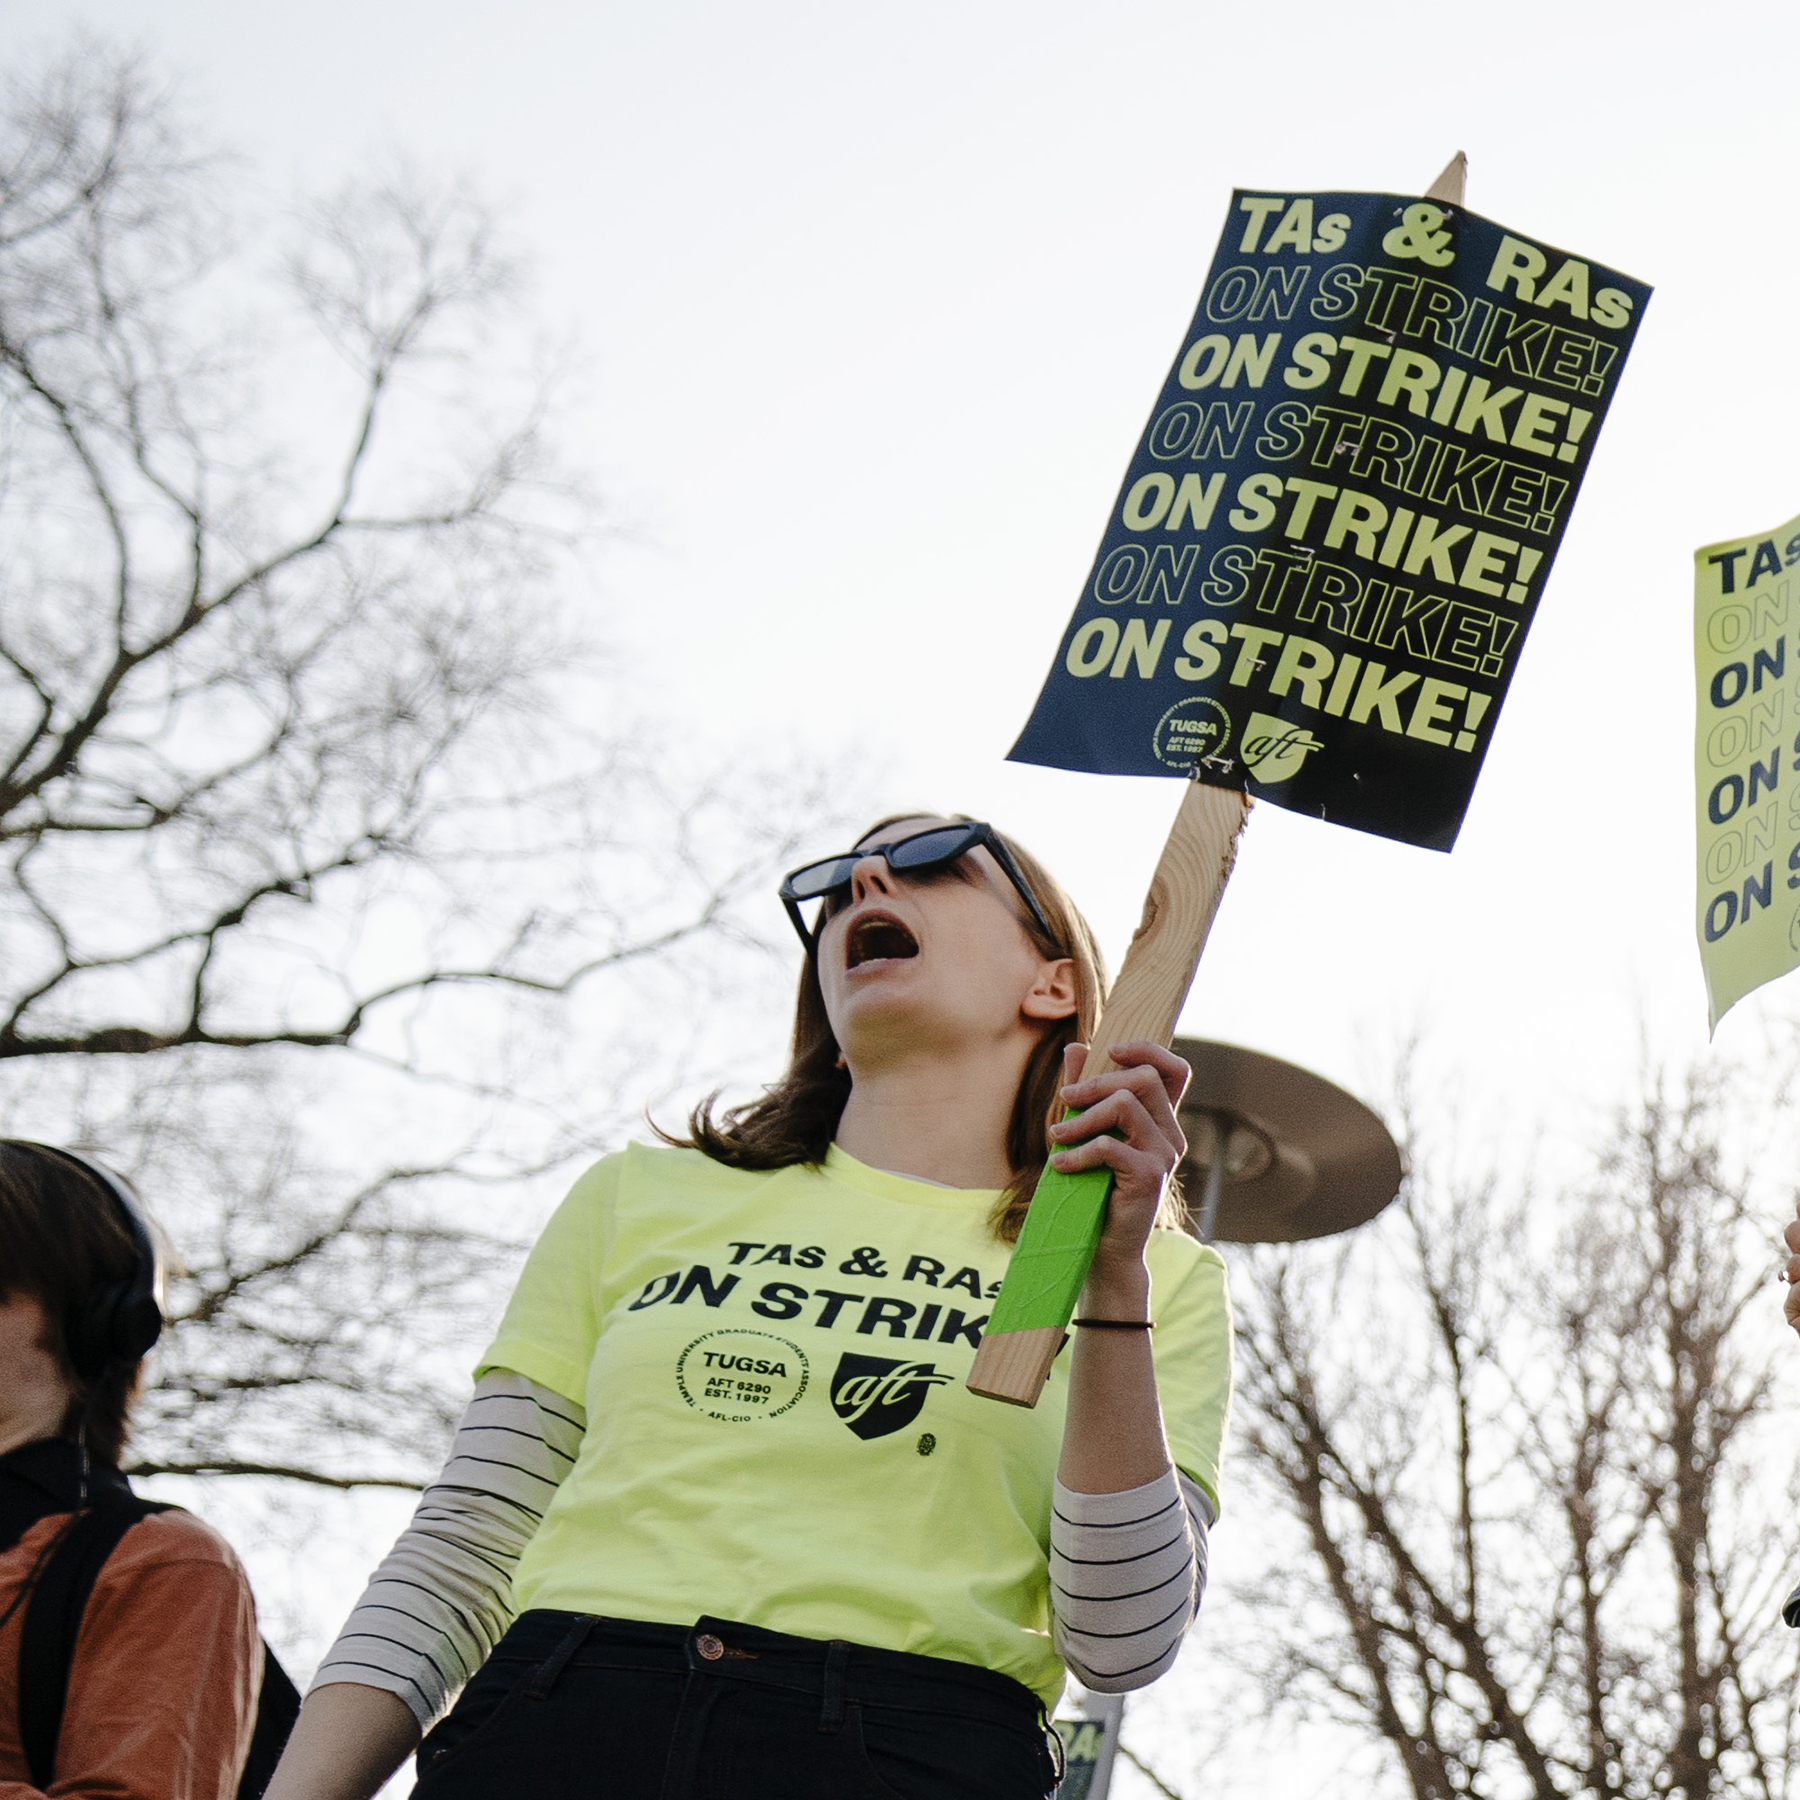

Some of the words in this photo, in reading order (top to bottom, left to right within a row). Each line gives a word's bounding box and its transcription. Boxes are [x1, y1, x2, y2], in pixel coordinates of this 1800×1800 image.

[1239, 197, 1351, 254] TAs
[1381, 203, 1455, 268] &
[1486, 236, 1633, 331] RAs
[1205, 264, 1312, 323] ON
[1311, 262, 1619, 398] STRIKE!
[1177, 333, 1281, 389] ON
[1283, 332, 1593, 464] STRIKE!
[1149, 401, 1258, 459] ON
[1256, 401, 1569, 536] STRIKE!
[1121, 472, 1226, 531] ON
[1229, 472, 1543, 604] STRIKE!
[1092, 544, 1198, 605] ON
[1201, 545, 1519, 677] STRIKE!
[1707, 580, 1790, 654] ON
[1064, 618, 1170, 679] ON
[1174, 618, 1492, 752] STRIKE!
[1710, 635, 1786, 709] ON
[1169, 719, 1217, 736] TUGSA
[1244, 728, 1324, 767] aft
[1707, 690, 1784, 767] ON
[1708, 746, 1780, 825] ON
[1705, 803, 1779, 886] ON
[1704, 861, 1773, 943] ON
[627, 1265, 742, 1312] ON
[839, 1246, 888, 1278] &
[703, 1352, 787, 1377] TUGSA
[705, 1387, 732, 1399] EST.
[736, 1393, 770, 1405] 1997
[707, 1377, 734, 1389] AFT
[737, 1381, 771, 1394] 6290
[835, 1362, 955, 1424] aft
[708, 1411, 751, 1422] AFL-CIO
